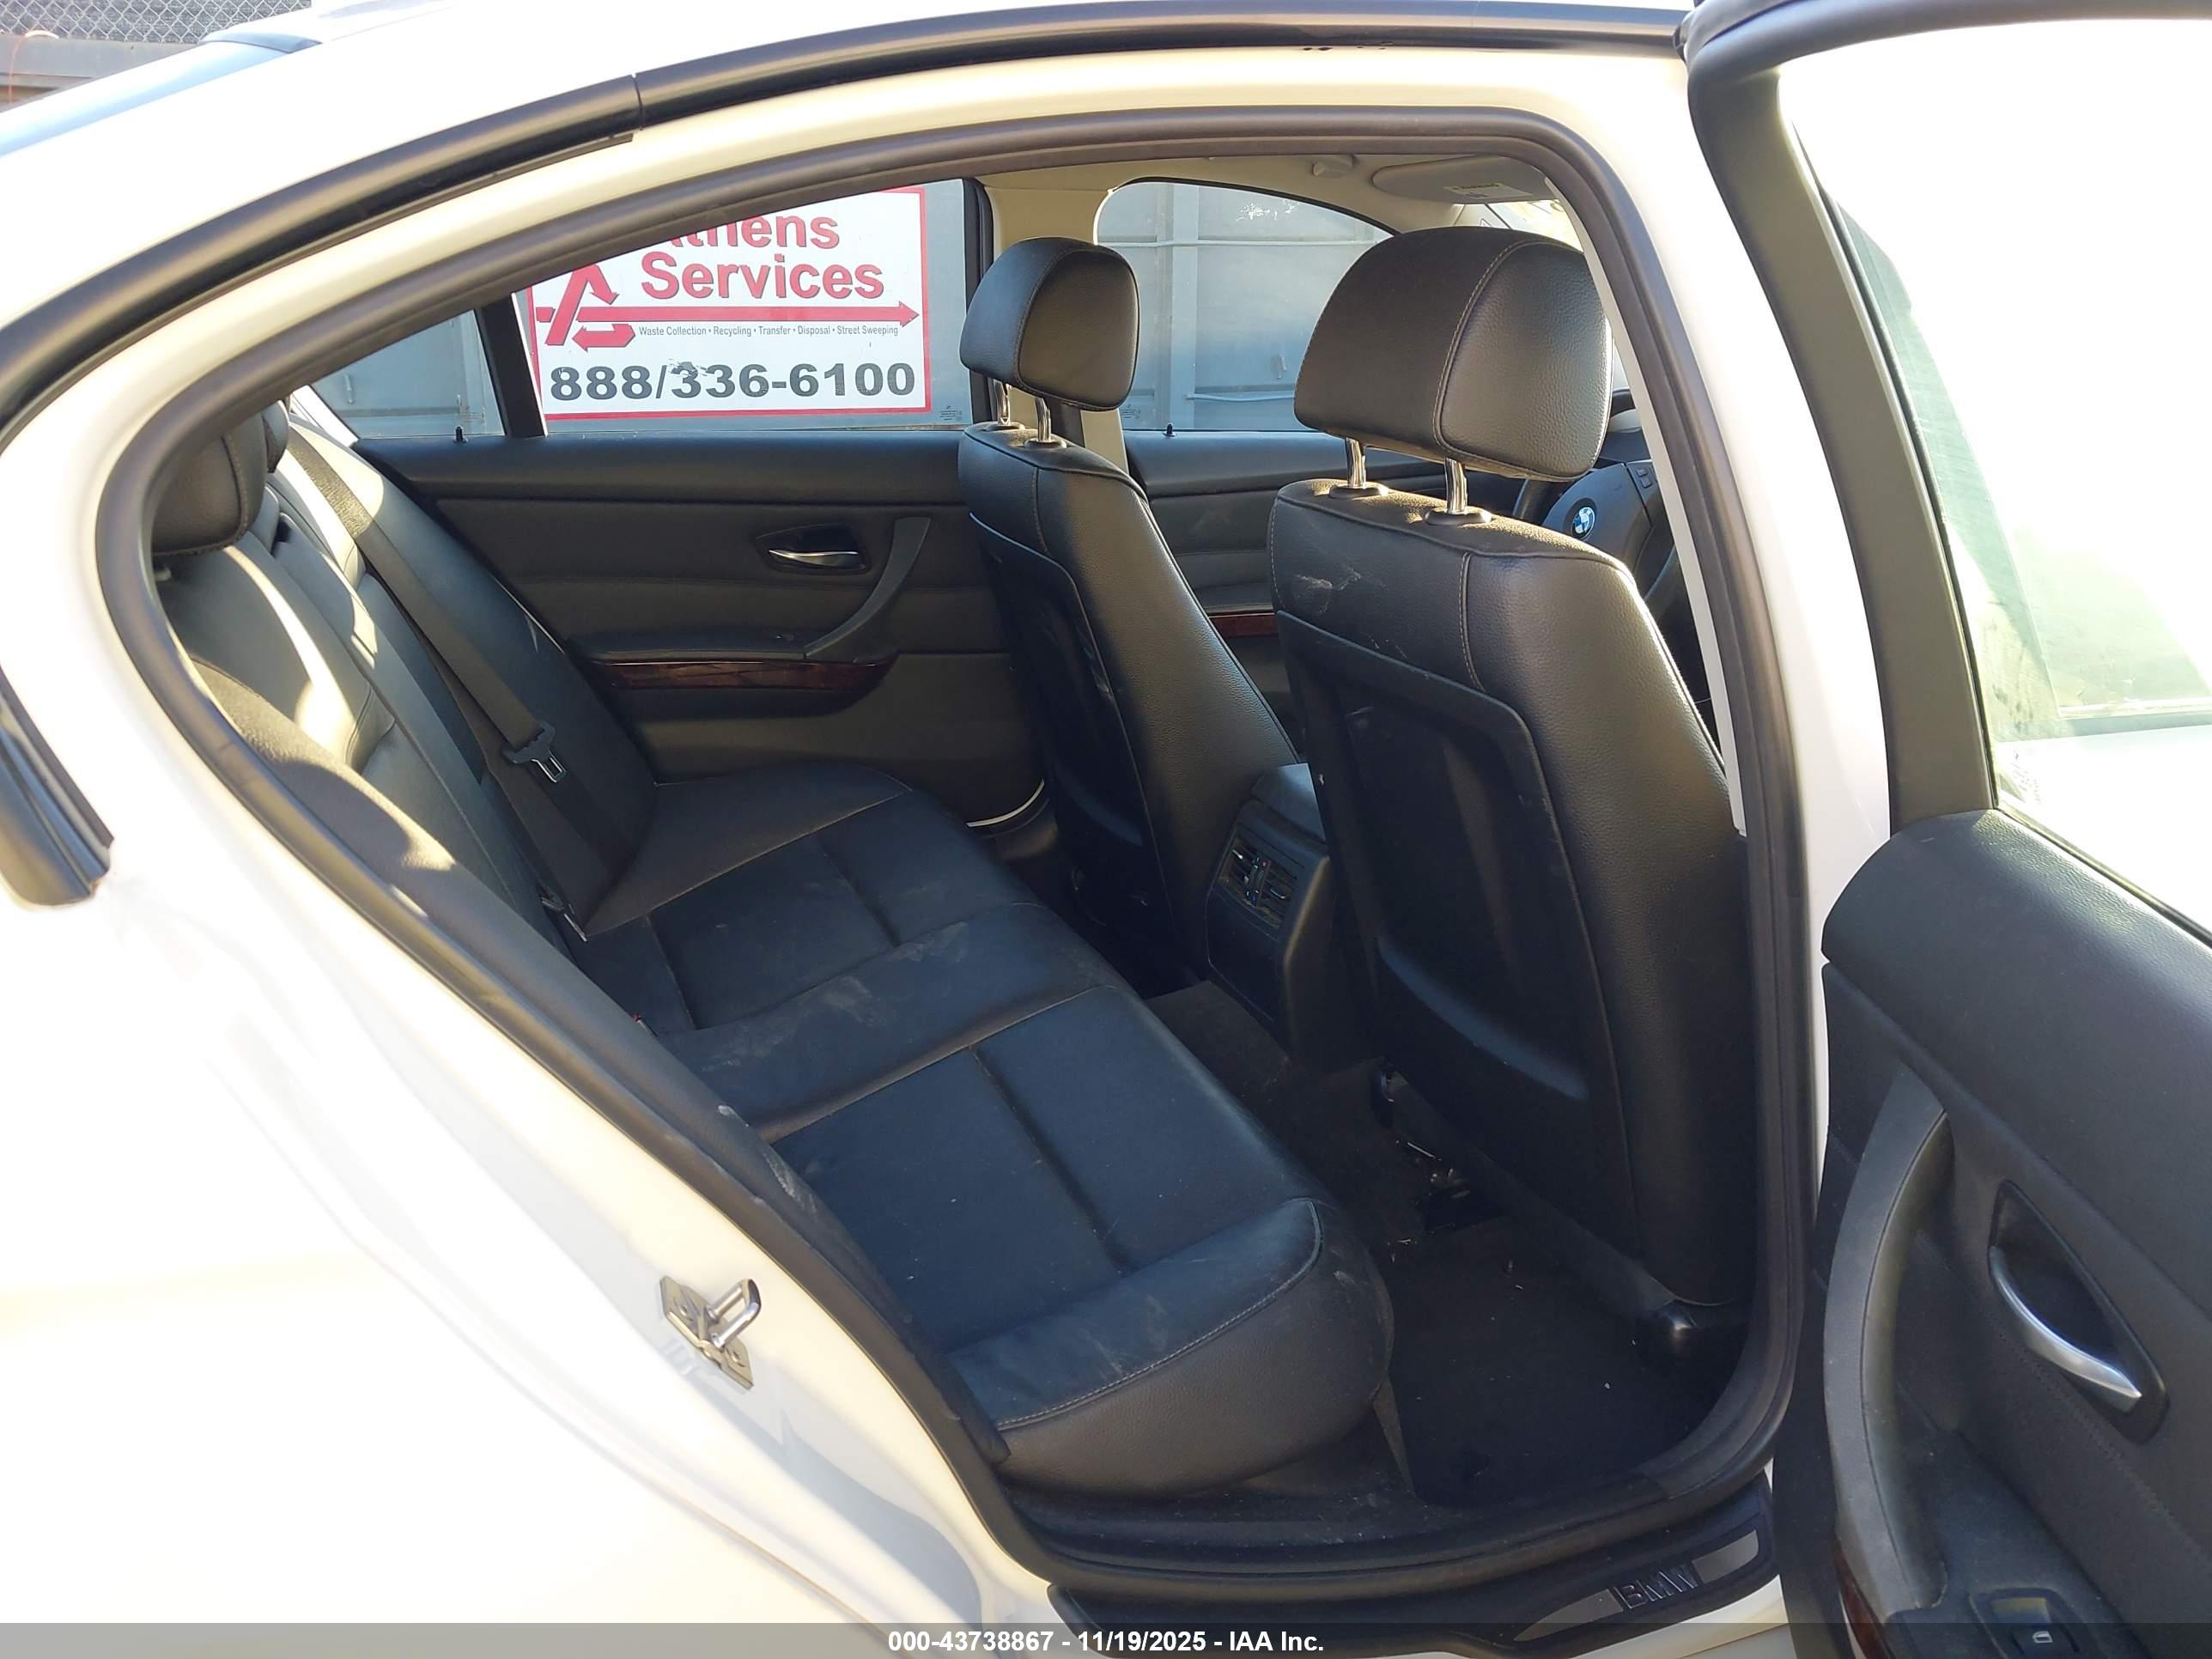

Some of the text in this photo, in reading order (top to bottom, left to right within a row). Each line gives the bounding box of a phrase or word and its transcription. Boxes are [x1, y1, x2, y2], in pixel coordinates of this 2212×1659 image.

[671, 215, 840, 249] hens
[641, 251, 884, 300] Services
[639, 325, 898, 337] Waste Collection Recycling Transfer Disposal Street Sweeping
[550, 362, 915, 401] 888/336-6100
[1613, 1565, 1698, 1610] BMW
